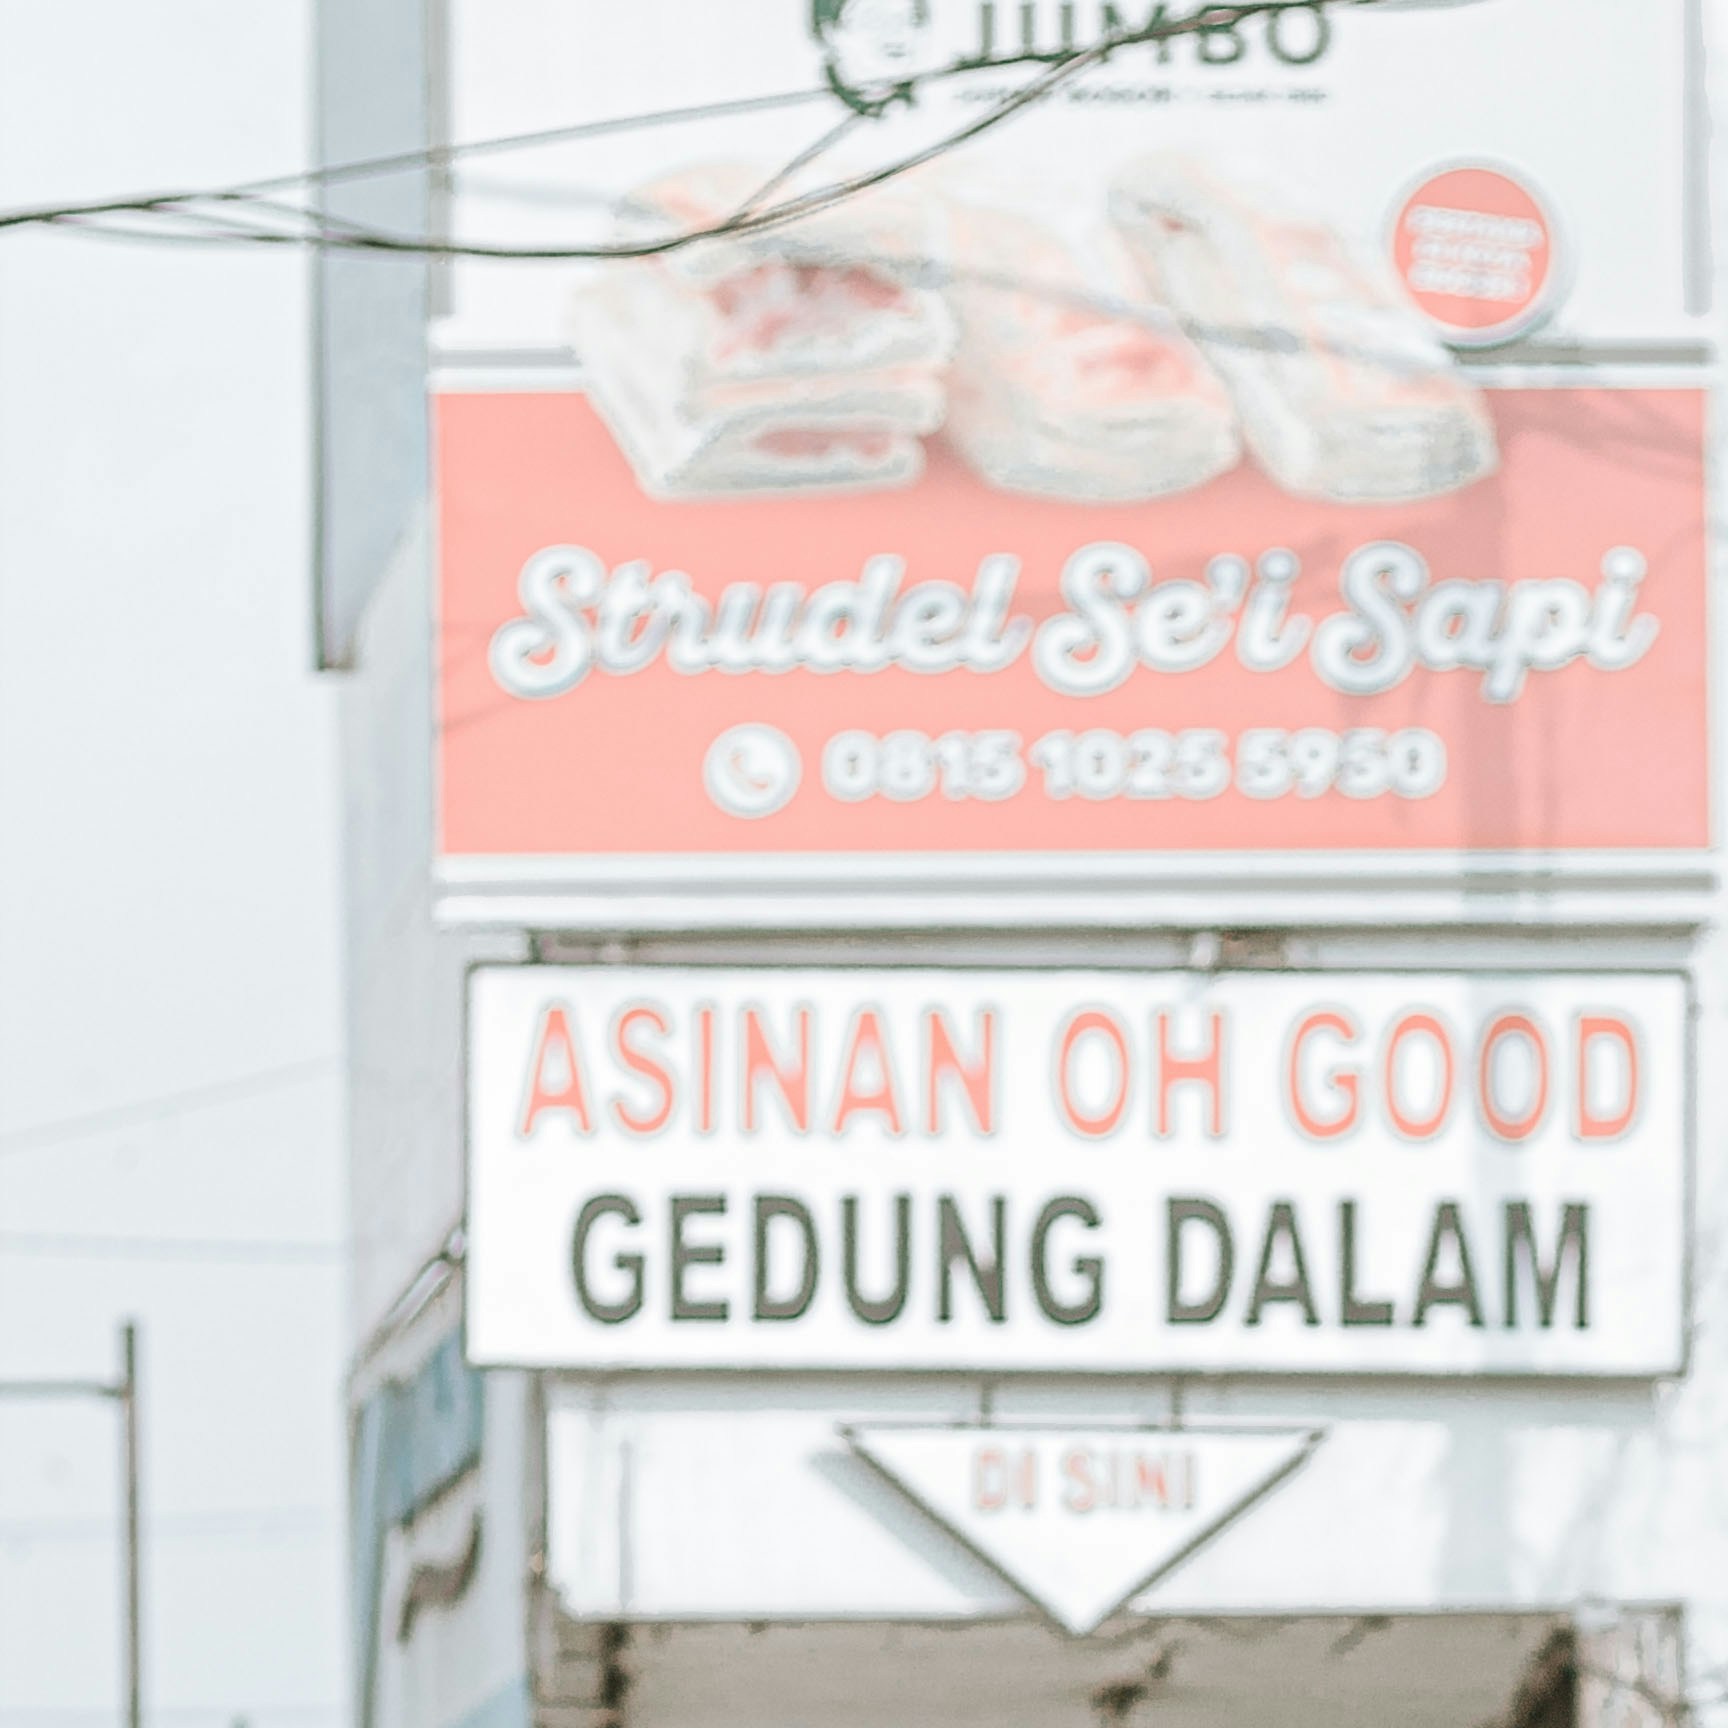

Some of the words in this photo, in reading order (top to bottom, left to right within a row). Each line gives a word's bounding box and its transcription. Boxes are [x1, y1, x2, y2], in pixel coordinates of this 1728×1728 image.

[487, 541, 1034, 700] Strudel
[1031, 541, 1310, 698] Se'i
[1308, 541, 1660, 704] Sapi
[820, 727, 1027, 803] 0815
[1030, 727, 1230, 802] 1025
[1235, 726, 1449, 800] 5950
[517, 1004, 997, 1138] ASINAN
[1056, 1010, 1226, 1139] OH
[1286, 1011, 1641, 1142] GOOD
[571, 1195, 1104, 1326] GEDUNG
[1164, 1197, 1592, 1330] DALAM
[973, 1448, 1036, 1512] DI
[1061, 1447, 1198, 1513] SINI
